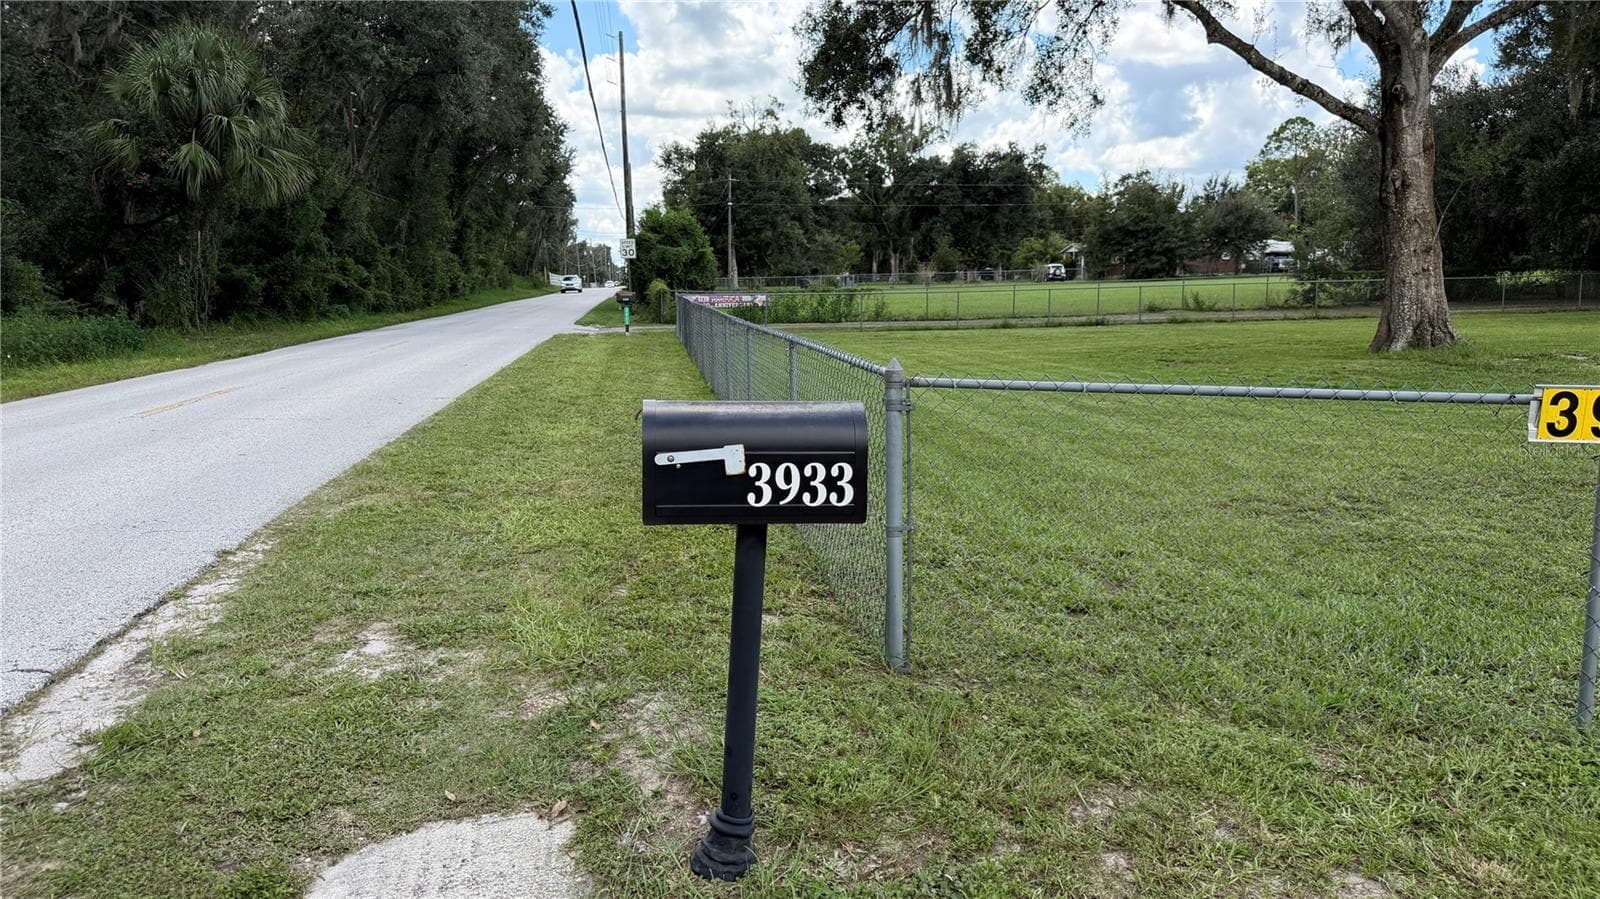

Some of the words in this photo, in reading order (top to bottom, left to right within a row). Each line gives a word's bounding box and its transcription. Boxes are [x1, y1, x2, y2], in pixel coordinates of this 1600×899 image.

[622, 248, 635, 257] 30
[1546, 391, 1600, 438] 3
[747, 462, 854, 507] 3933
